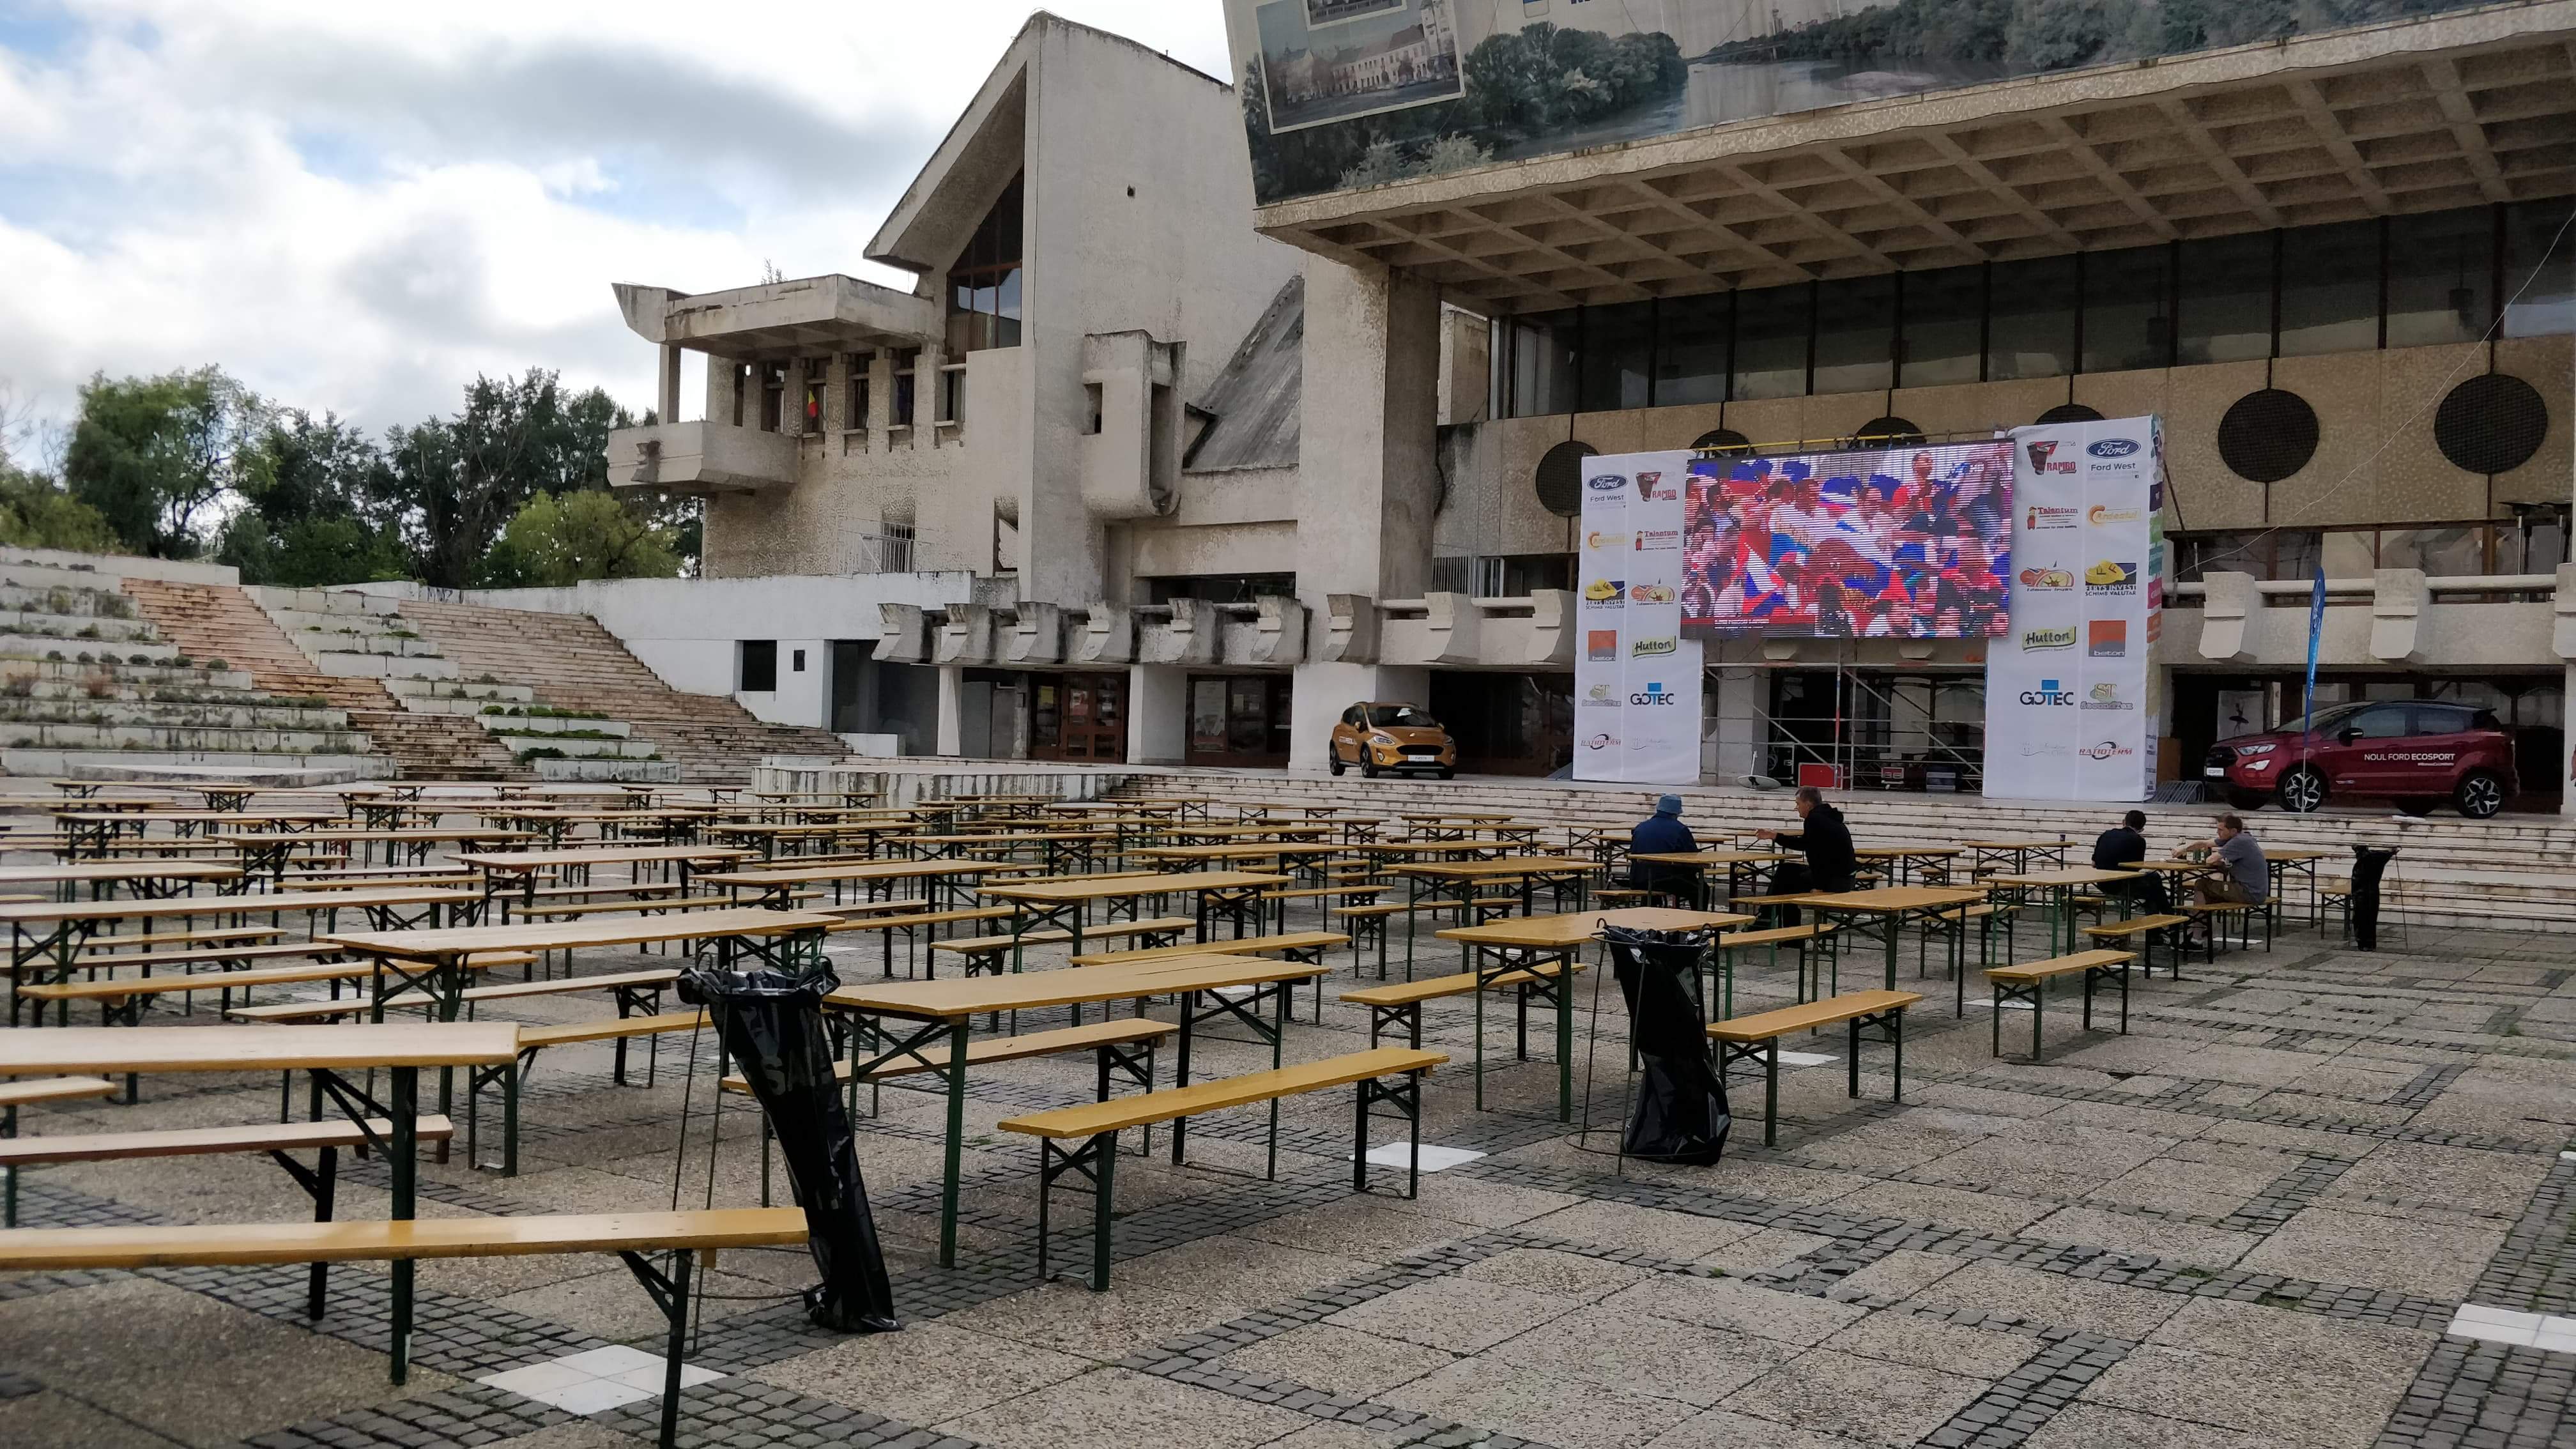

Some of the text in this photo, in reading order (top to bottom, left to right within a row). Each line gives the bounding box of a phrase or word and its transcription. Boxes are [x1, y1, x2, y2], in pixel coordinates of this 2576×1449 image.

[2097, 441, 2131, 456] Ford
[2046, 461, 2076, 471] RAMBO
[1594, 477, 1620, 489] Ford
[1652, 489, 1676, 498] RAMBO
[2025, 632, 2070, 645] Hutton
[1634, 640, 1672, 653] Hutton
[1630, 693, 1675, 705] GOTEC
[2020, 691, 2074, 706] GOTEC
